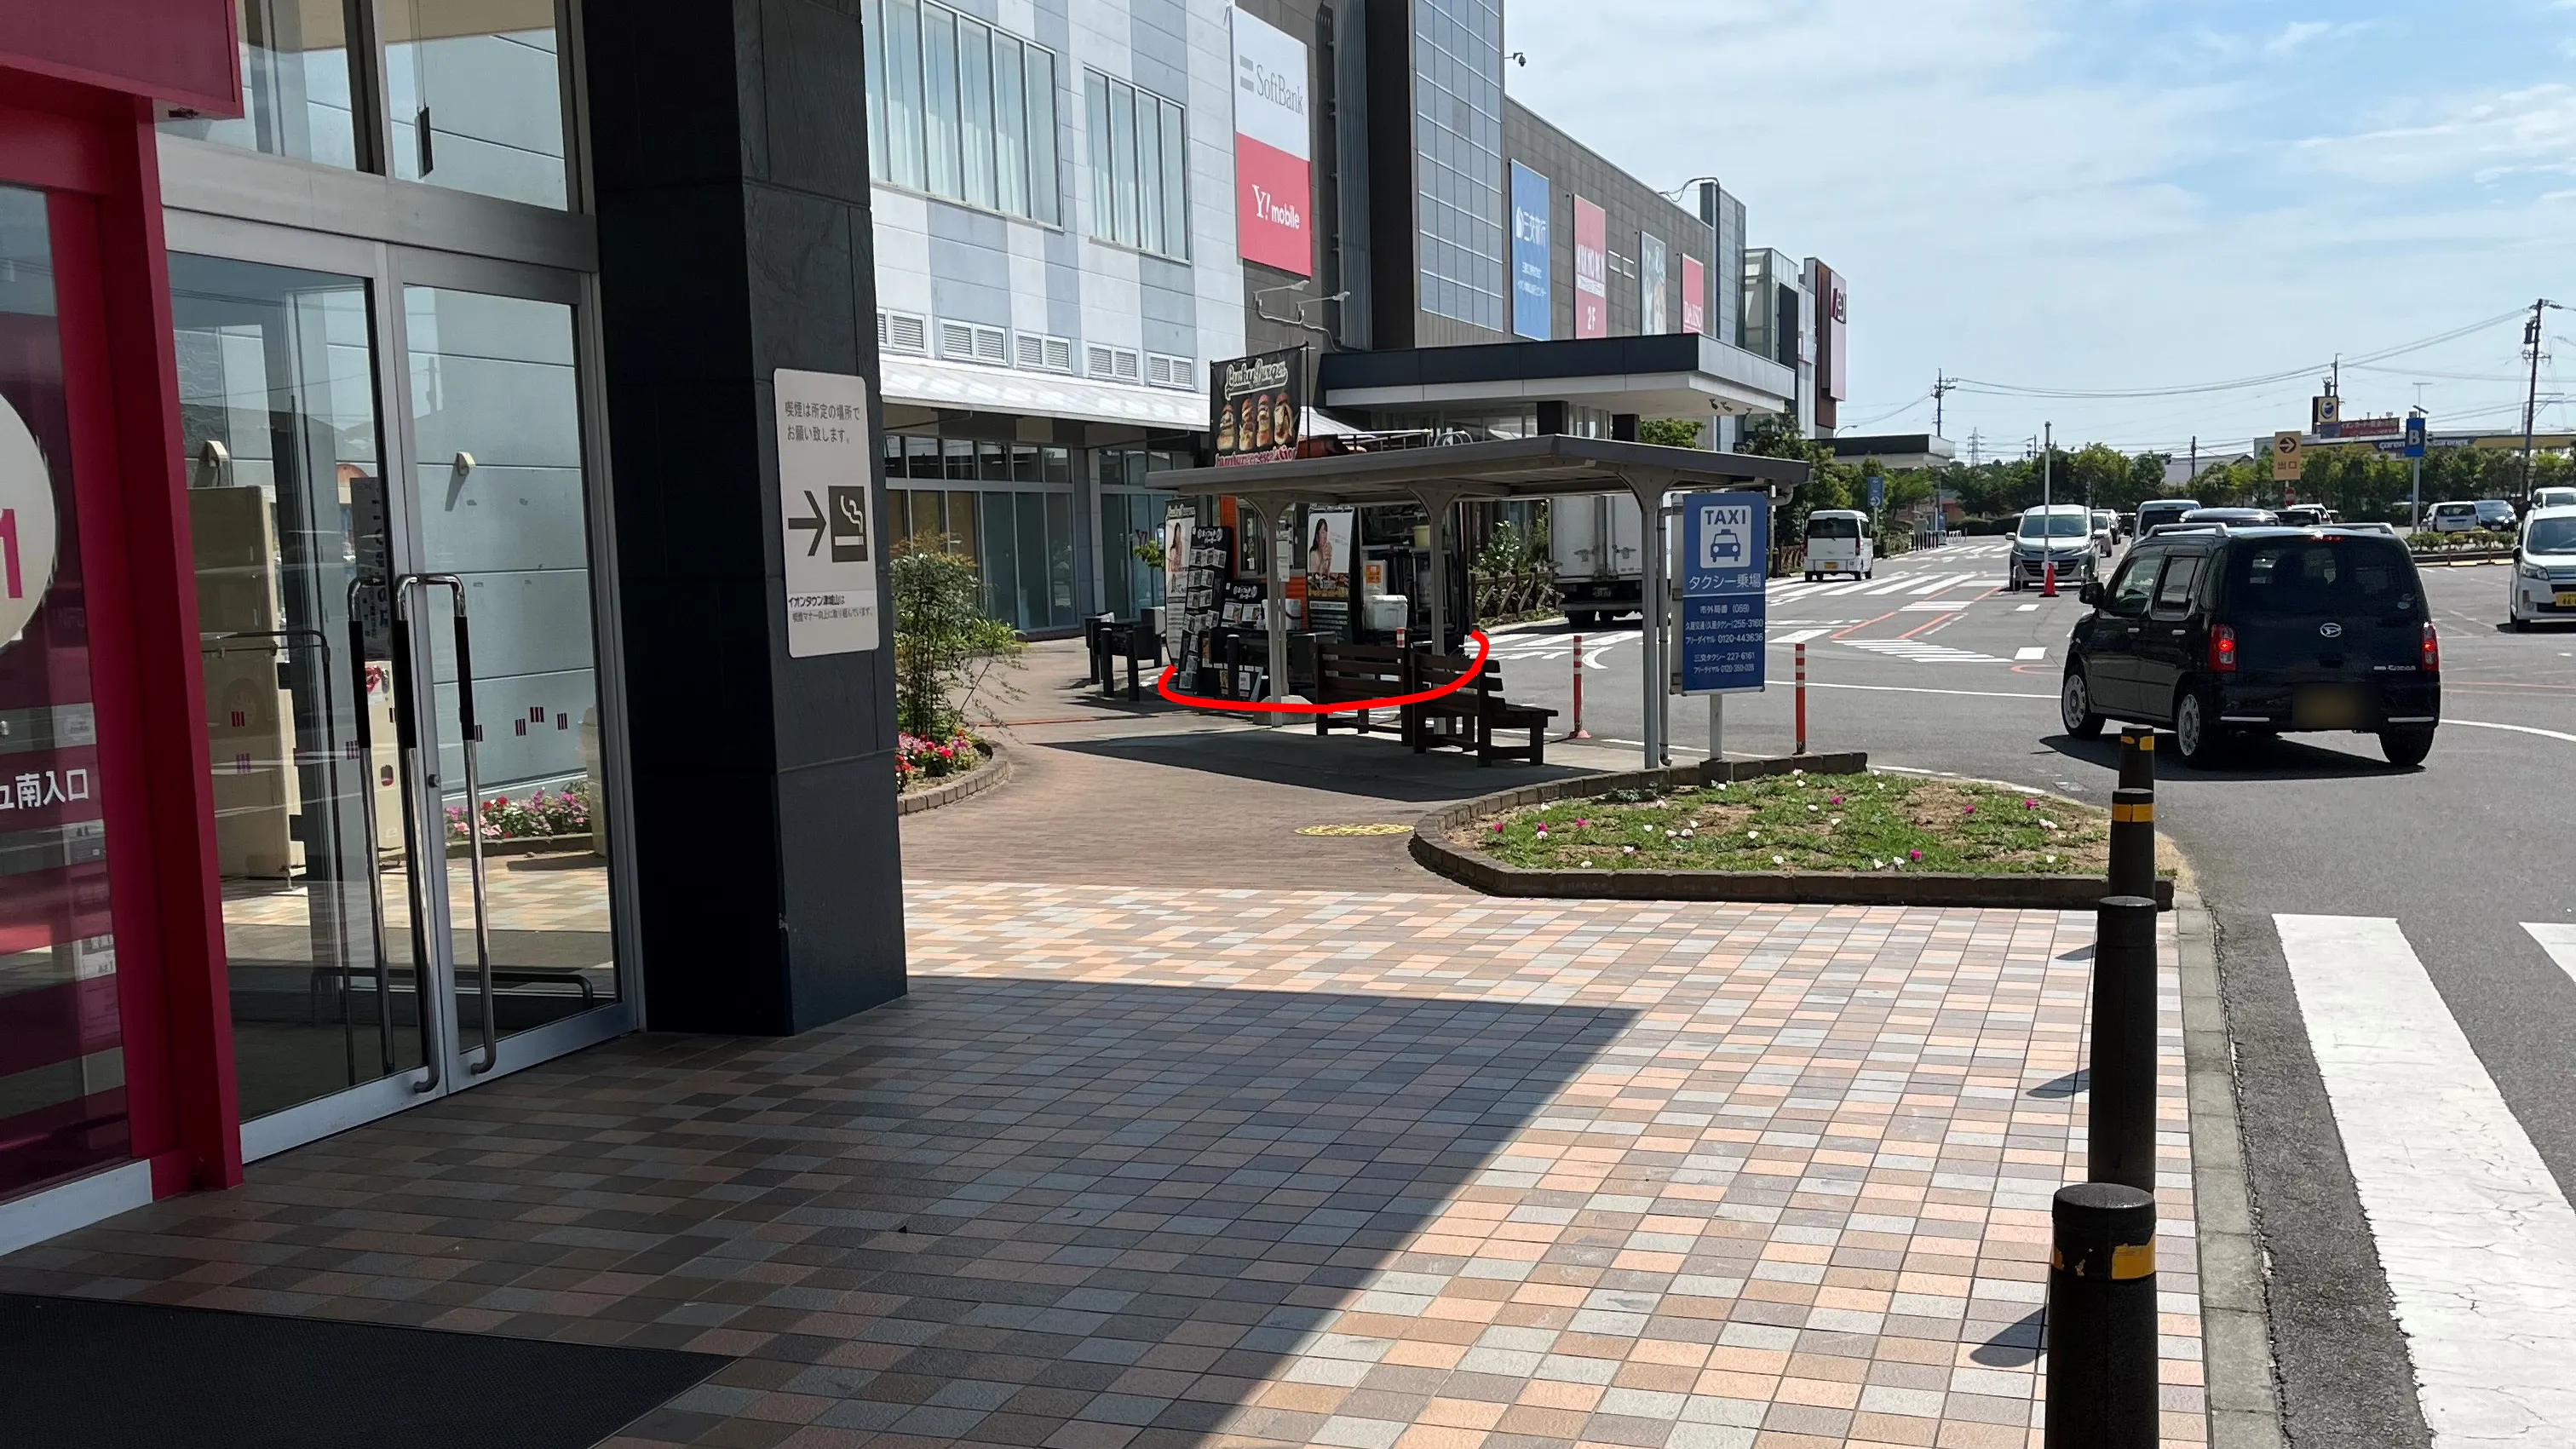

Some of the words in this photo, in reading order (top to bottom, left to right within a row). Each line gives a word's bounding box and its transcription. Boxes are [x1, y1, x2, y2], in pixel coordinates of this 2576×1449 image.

[1256, 64, 1304, 116] SoftBank
[1587, 306, 1596, 331] 2F
[785, 400, 860, 421] 喫煙は所定の場所で
[787, 425, 850, 444] お願い致します。
[2408, 429, 2420, 445] B
[2277, 461, 2297, 470] 出口
[1705, 509, 1746, 525] TAXI
[1688, 572, 1762, 590] タクシー乗場
